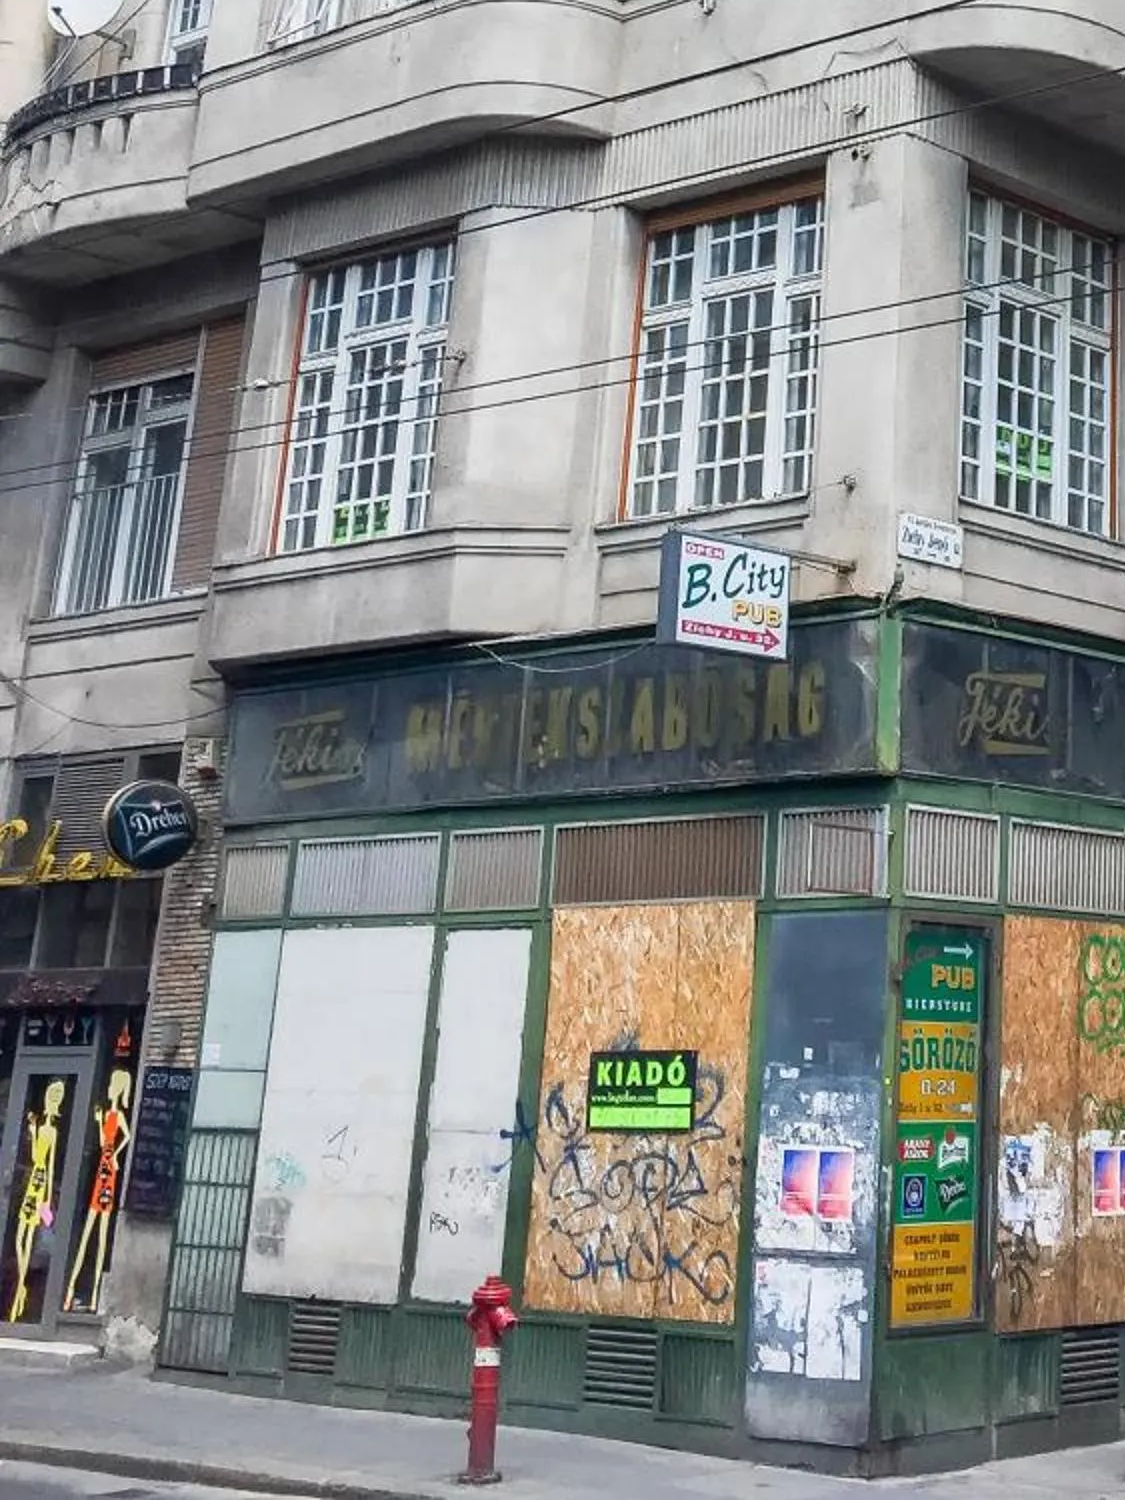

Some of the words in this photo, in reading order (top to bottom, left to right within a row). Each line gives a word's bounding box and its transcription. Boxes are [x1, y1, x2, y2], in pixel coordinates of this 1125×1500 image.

[686, 542, 724, 560] OPEN
[732, 600, 783, 628] PUB
[130, 810, 188, 837] Dreher
[931, 964, 975, 990] PUB
[597, 1055, 685, 1087] KIADÓ
